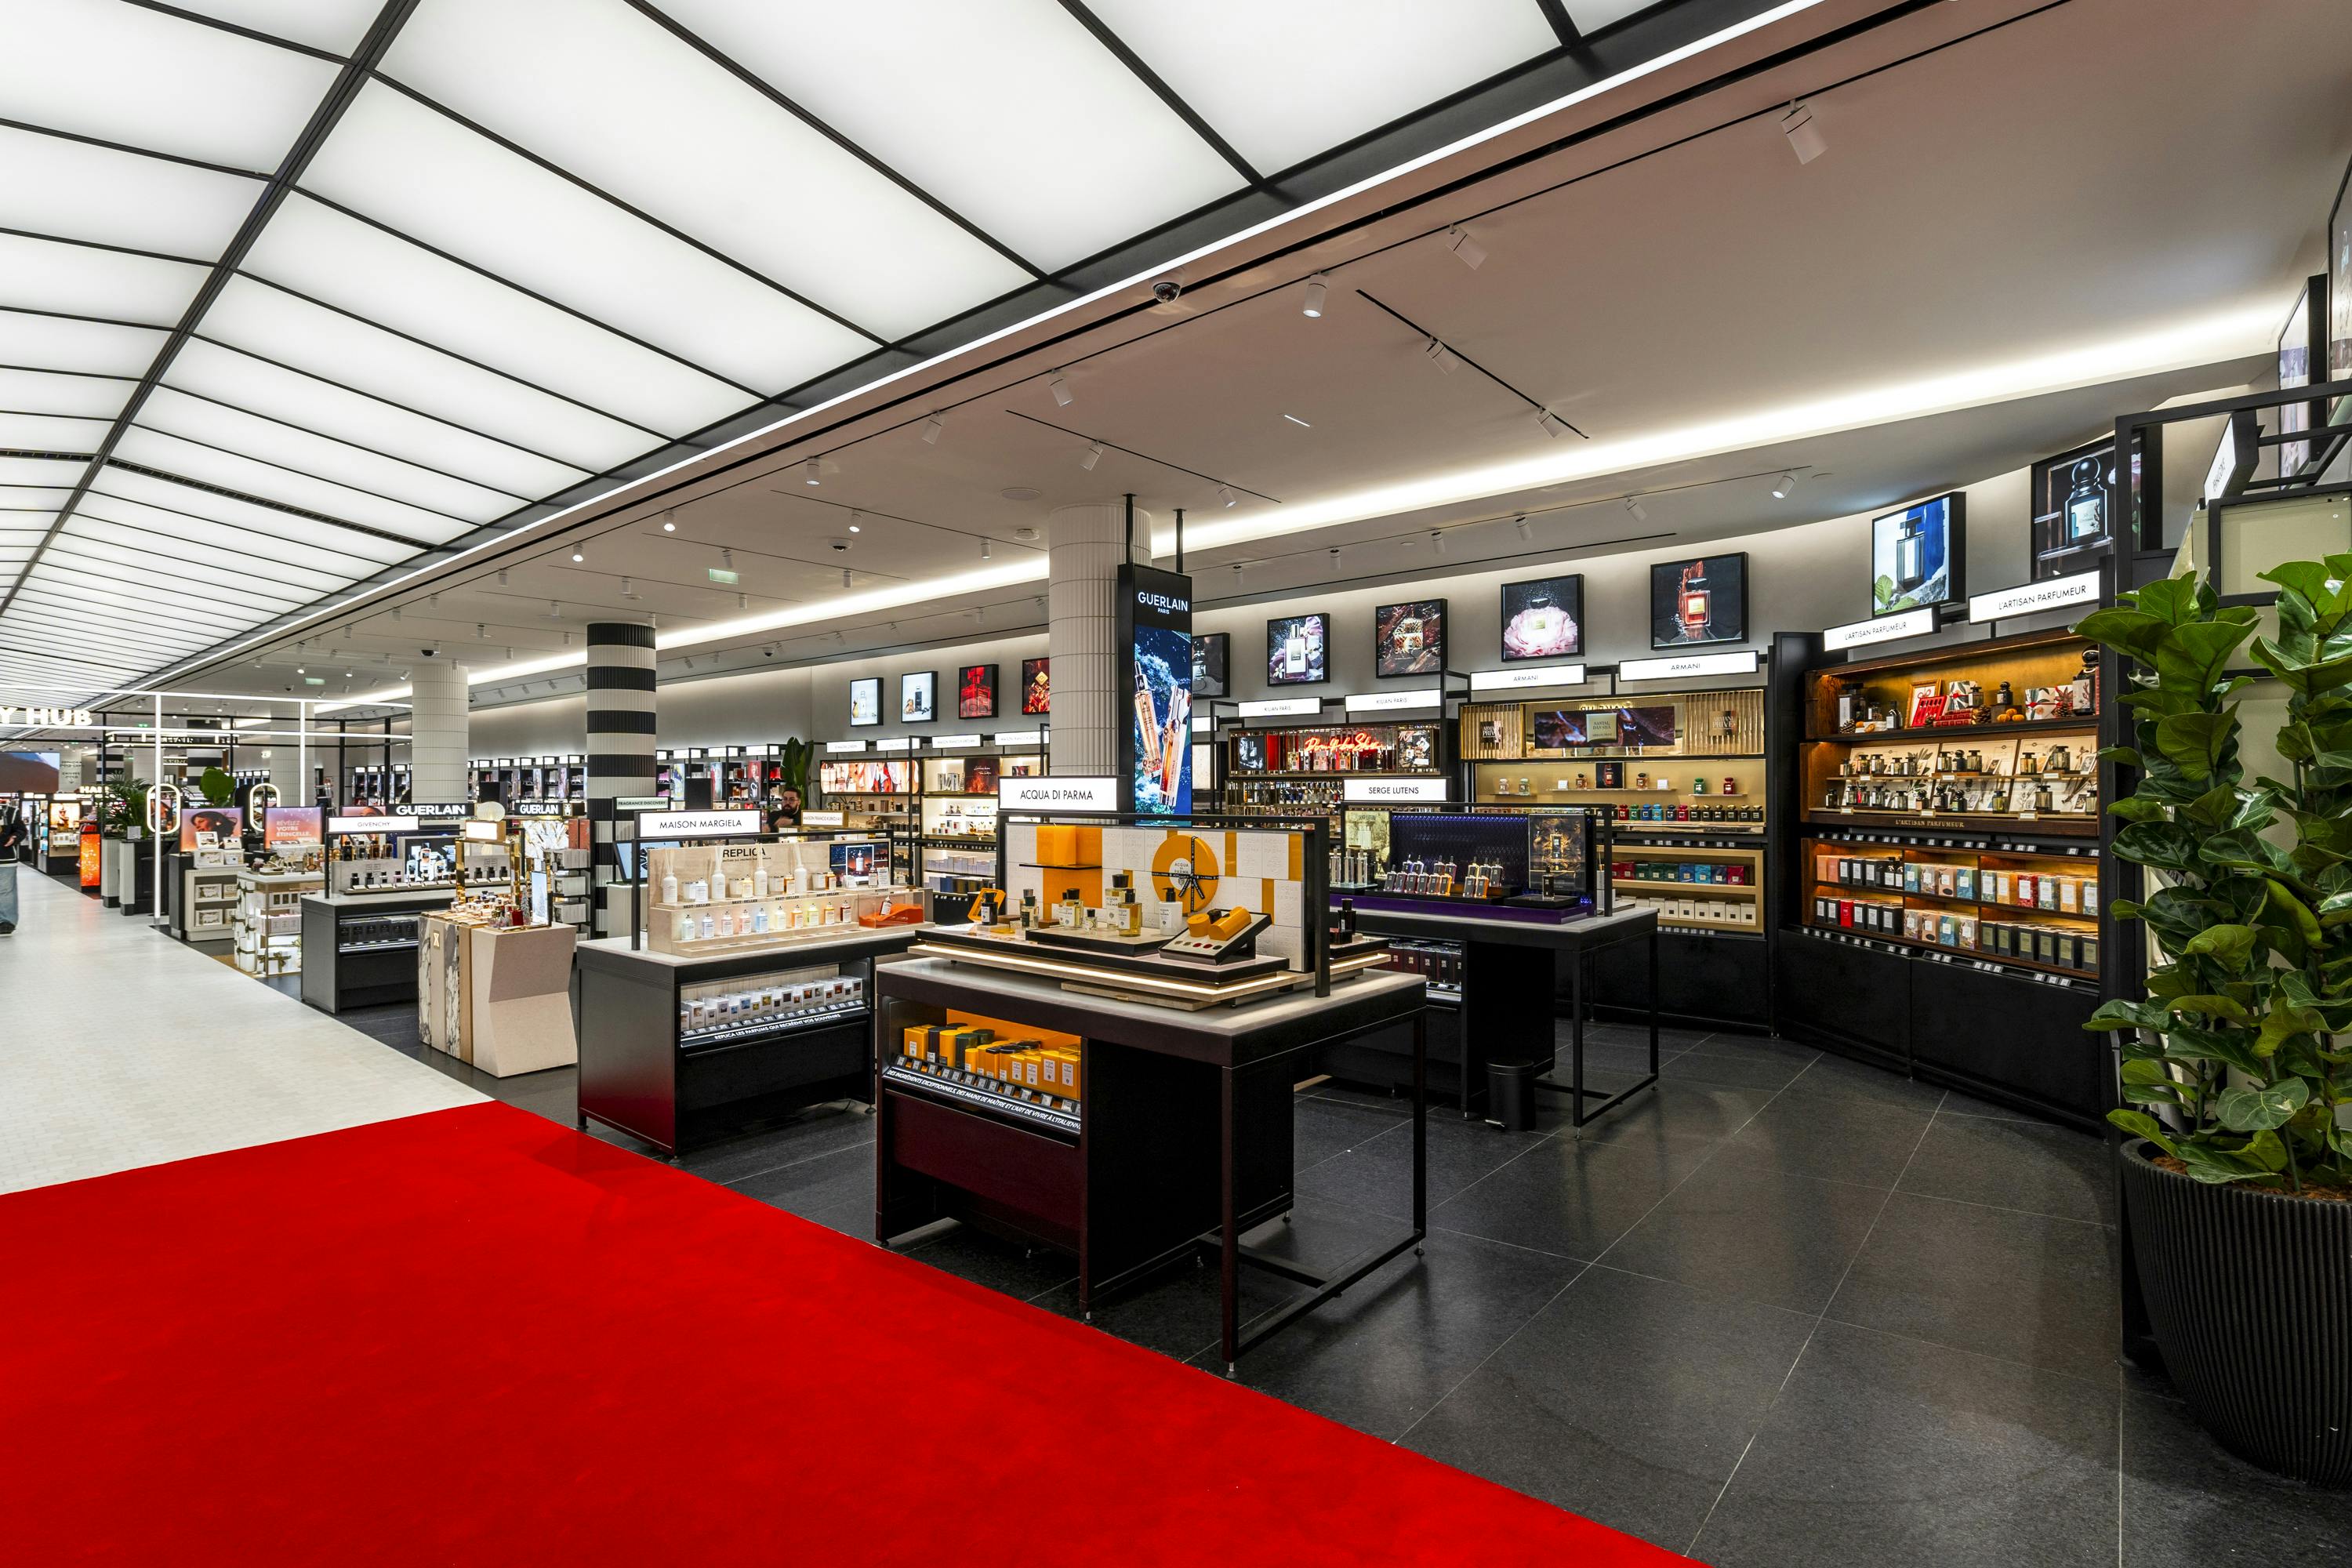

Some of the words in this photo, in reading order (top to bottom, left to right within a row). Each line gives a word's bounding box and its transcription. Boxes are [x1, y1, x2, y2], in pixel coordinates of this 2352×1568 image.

[1138, 591, 1189, 612] GUERLAIN
[1998, 596, 2035, 610] L'ARTISAN
[2037, 585, 2086, 603] PARFUMEUR
[1844, 630, 1871, 641] L'ARTISAN
[1872, 622, 1907, 634] PARFUMEUR
[26, 707, 93, 726] HUB
[1020, 789, 1050, 800] ACQUA
[1052, 789, 1061, 800] DI
[1063, 789, 1094, 800] PARMA
[395, 804, 466, 816] GUERLAIN
[519, 804, 559, 815] GUERLAIN
[659, 820, 697, 829] MAISON
[699, 819, 742, 828] MARGIELA
[745, 1026, 769, 1035] PARFUMS
[814, 1013, 840, 1022] SOUVENIRS
[895, 1072, 923, 1084] INGRÉDIENTS
[921, 1079, 956, 1094] EXCEPTIONNELS,
[956, 1088, 965, 1097] DES
[965, 1091, 981, 1102] MAINS
[987, 1096, 1005, 1108] MAÎTRE
[1011, 1104, 1025, 1113] L'ART
[1031, 1109, 1047, 1120] VIVRE
[1047, 1113, 1053, 1122] À
[1052, 1116, 1081, 1130] L'ITALIENN
